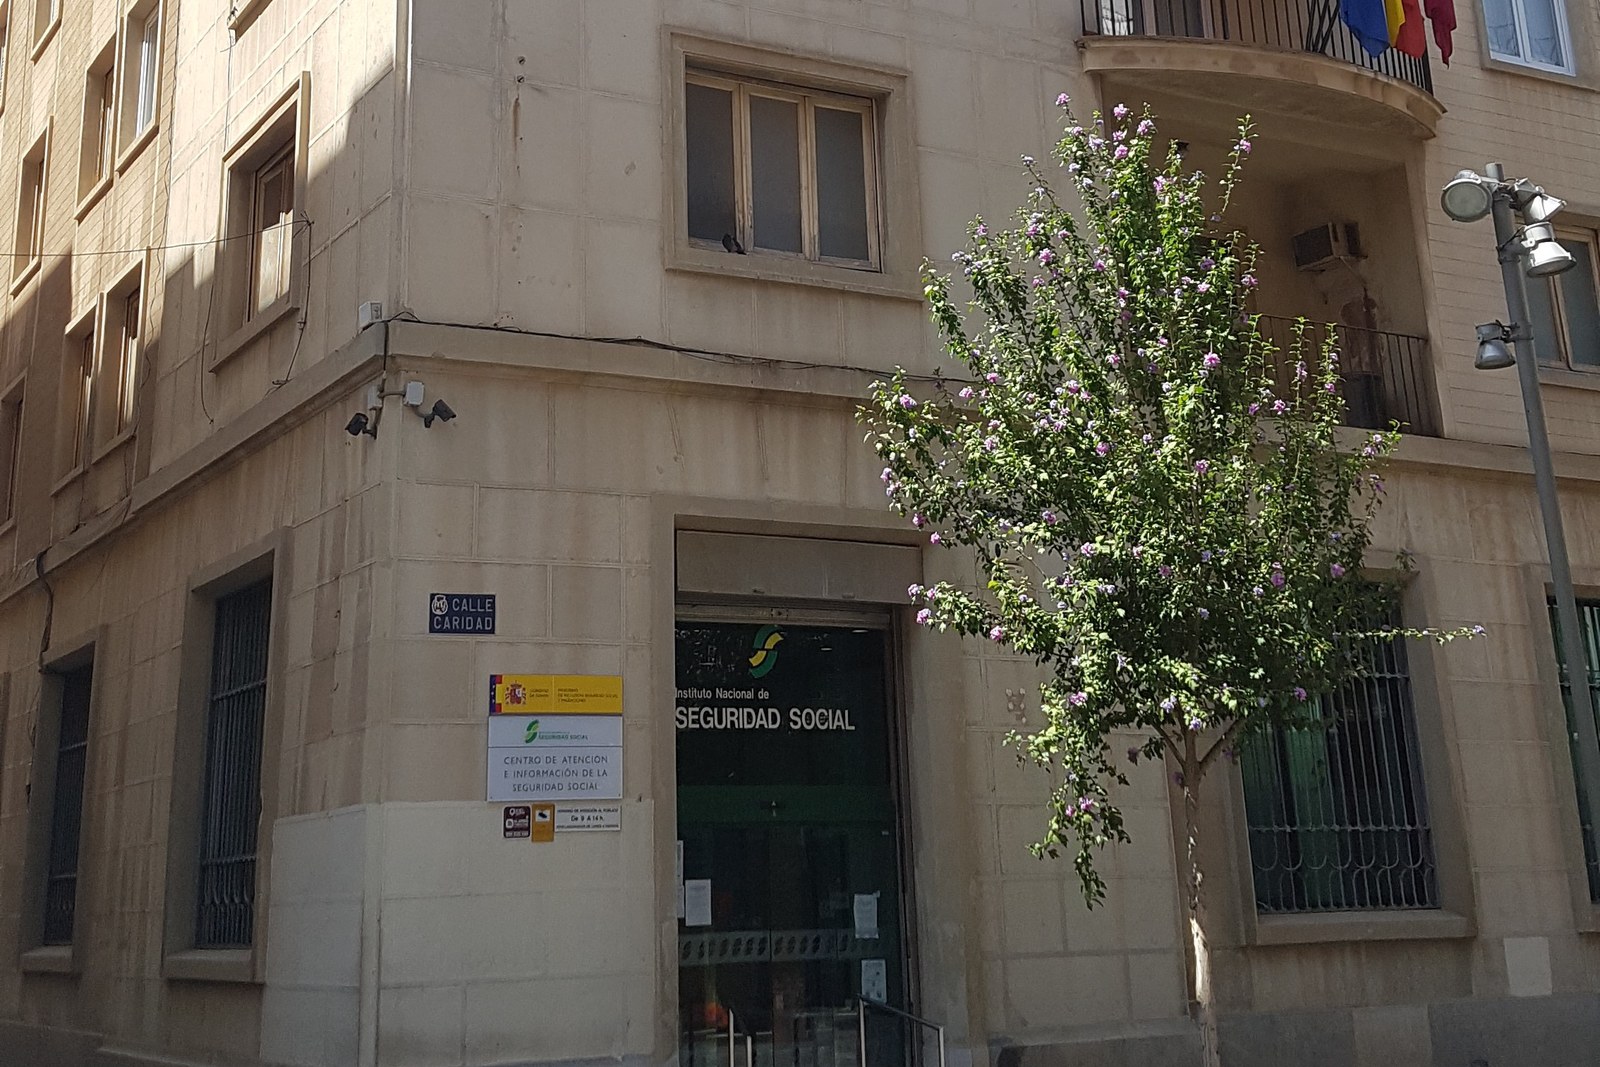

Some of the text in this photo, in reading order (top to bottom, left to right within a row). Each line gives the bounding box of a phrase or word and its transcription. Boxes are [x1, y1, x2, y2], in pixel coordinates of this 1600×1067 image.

[452, 598, 493, 612] CALLE
[433, 616, 493, 630] CARIDAD
[716, 687, 754, 699] Nacional
[758, 688, 769, 699] de
[675, 706, 856, 731] SEGURIDAD SOCIAL
[503, 756, 542, 765] CENTRO
[545, 756, 557, 764] DE
[504, 768, 608, 778] E INFORMACIÓN DE LA
[512, 782, 598, 792] SEGURIDAD SOCIAL
